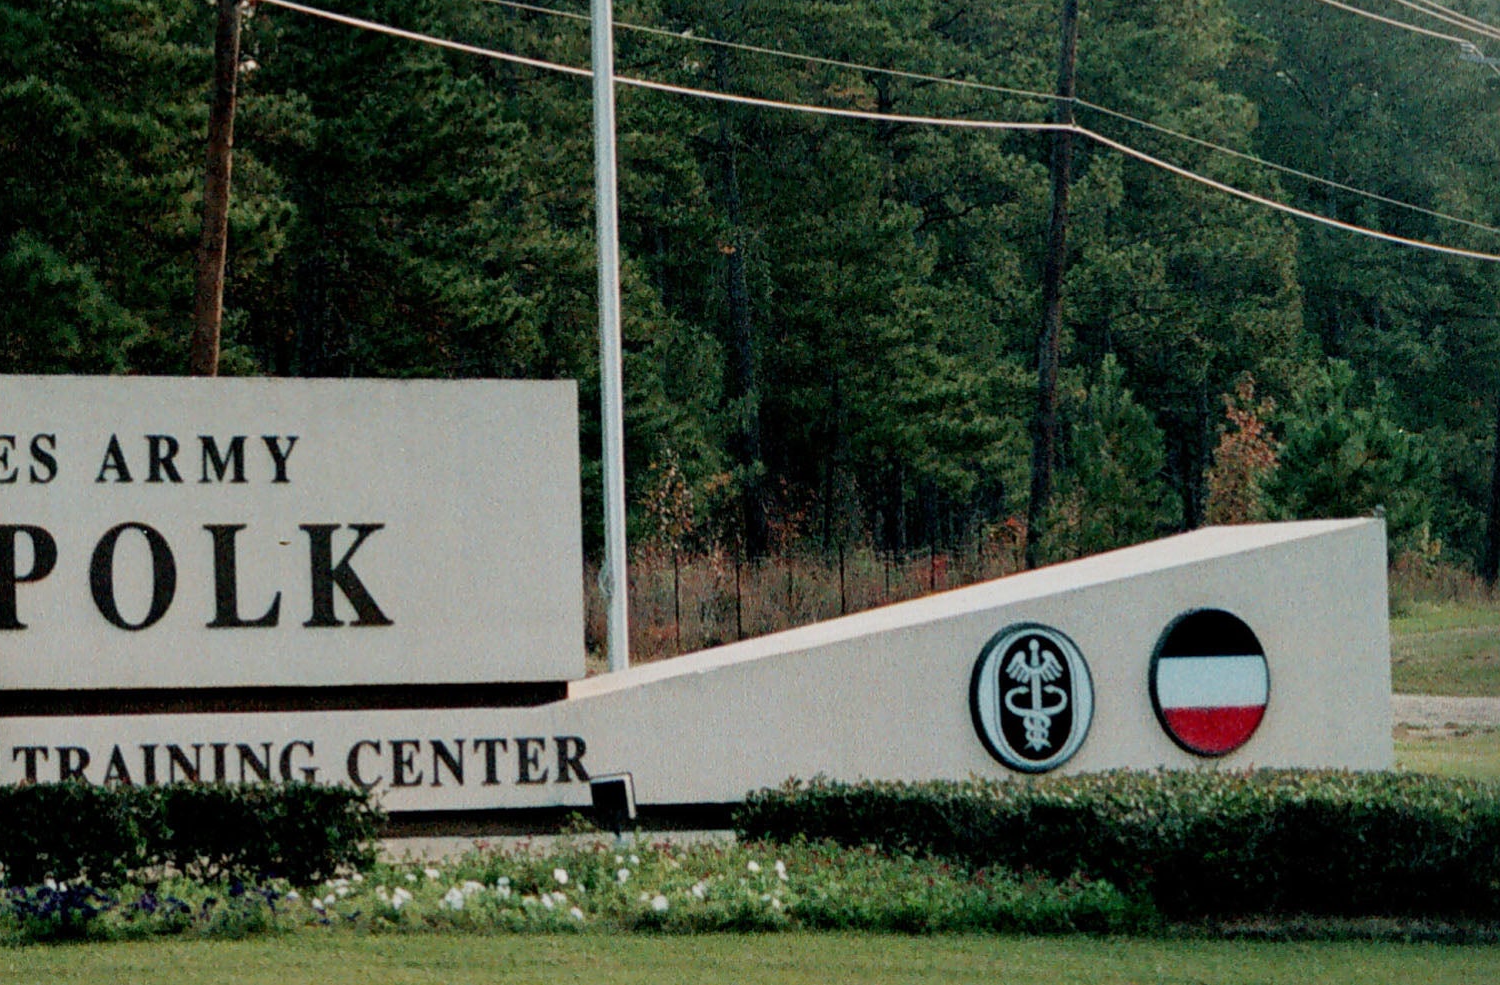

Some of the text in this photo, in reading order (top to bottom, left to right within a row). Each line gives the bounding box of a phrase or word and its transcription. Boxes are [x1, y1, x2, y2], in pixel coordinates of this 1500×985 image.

[94, 432, 301, 485] ARMY
[12, 739, 320, 787] TRAINING
[346, 735, 592, 792] CENTER
